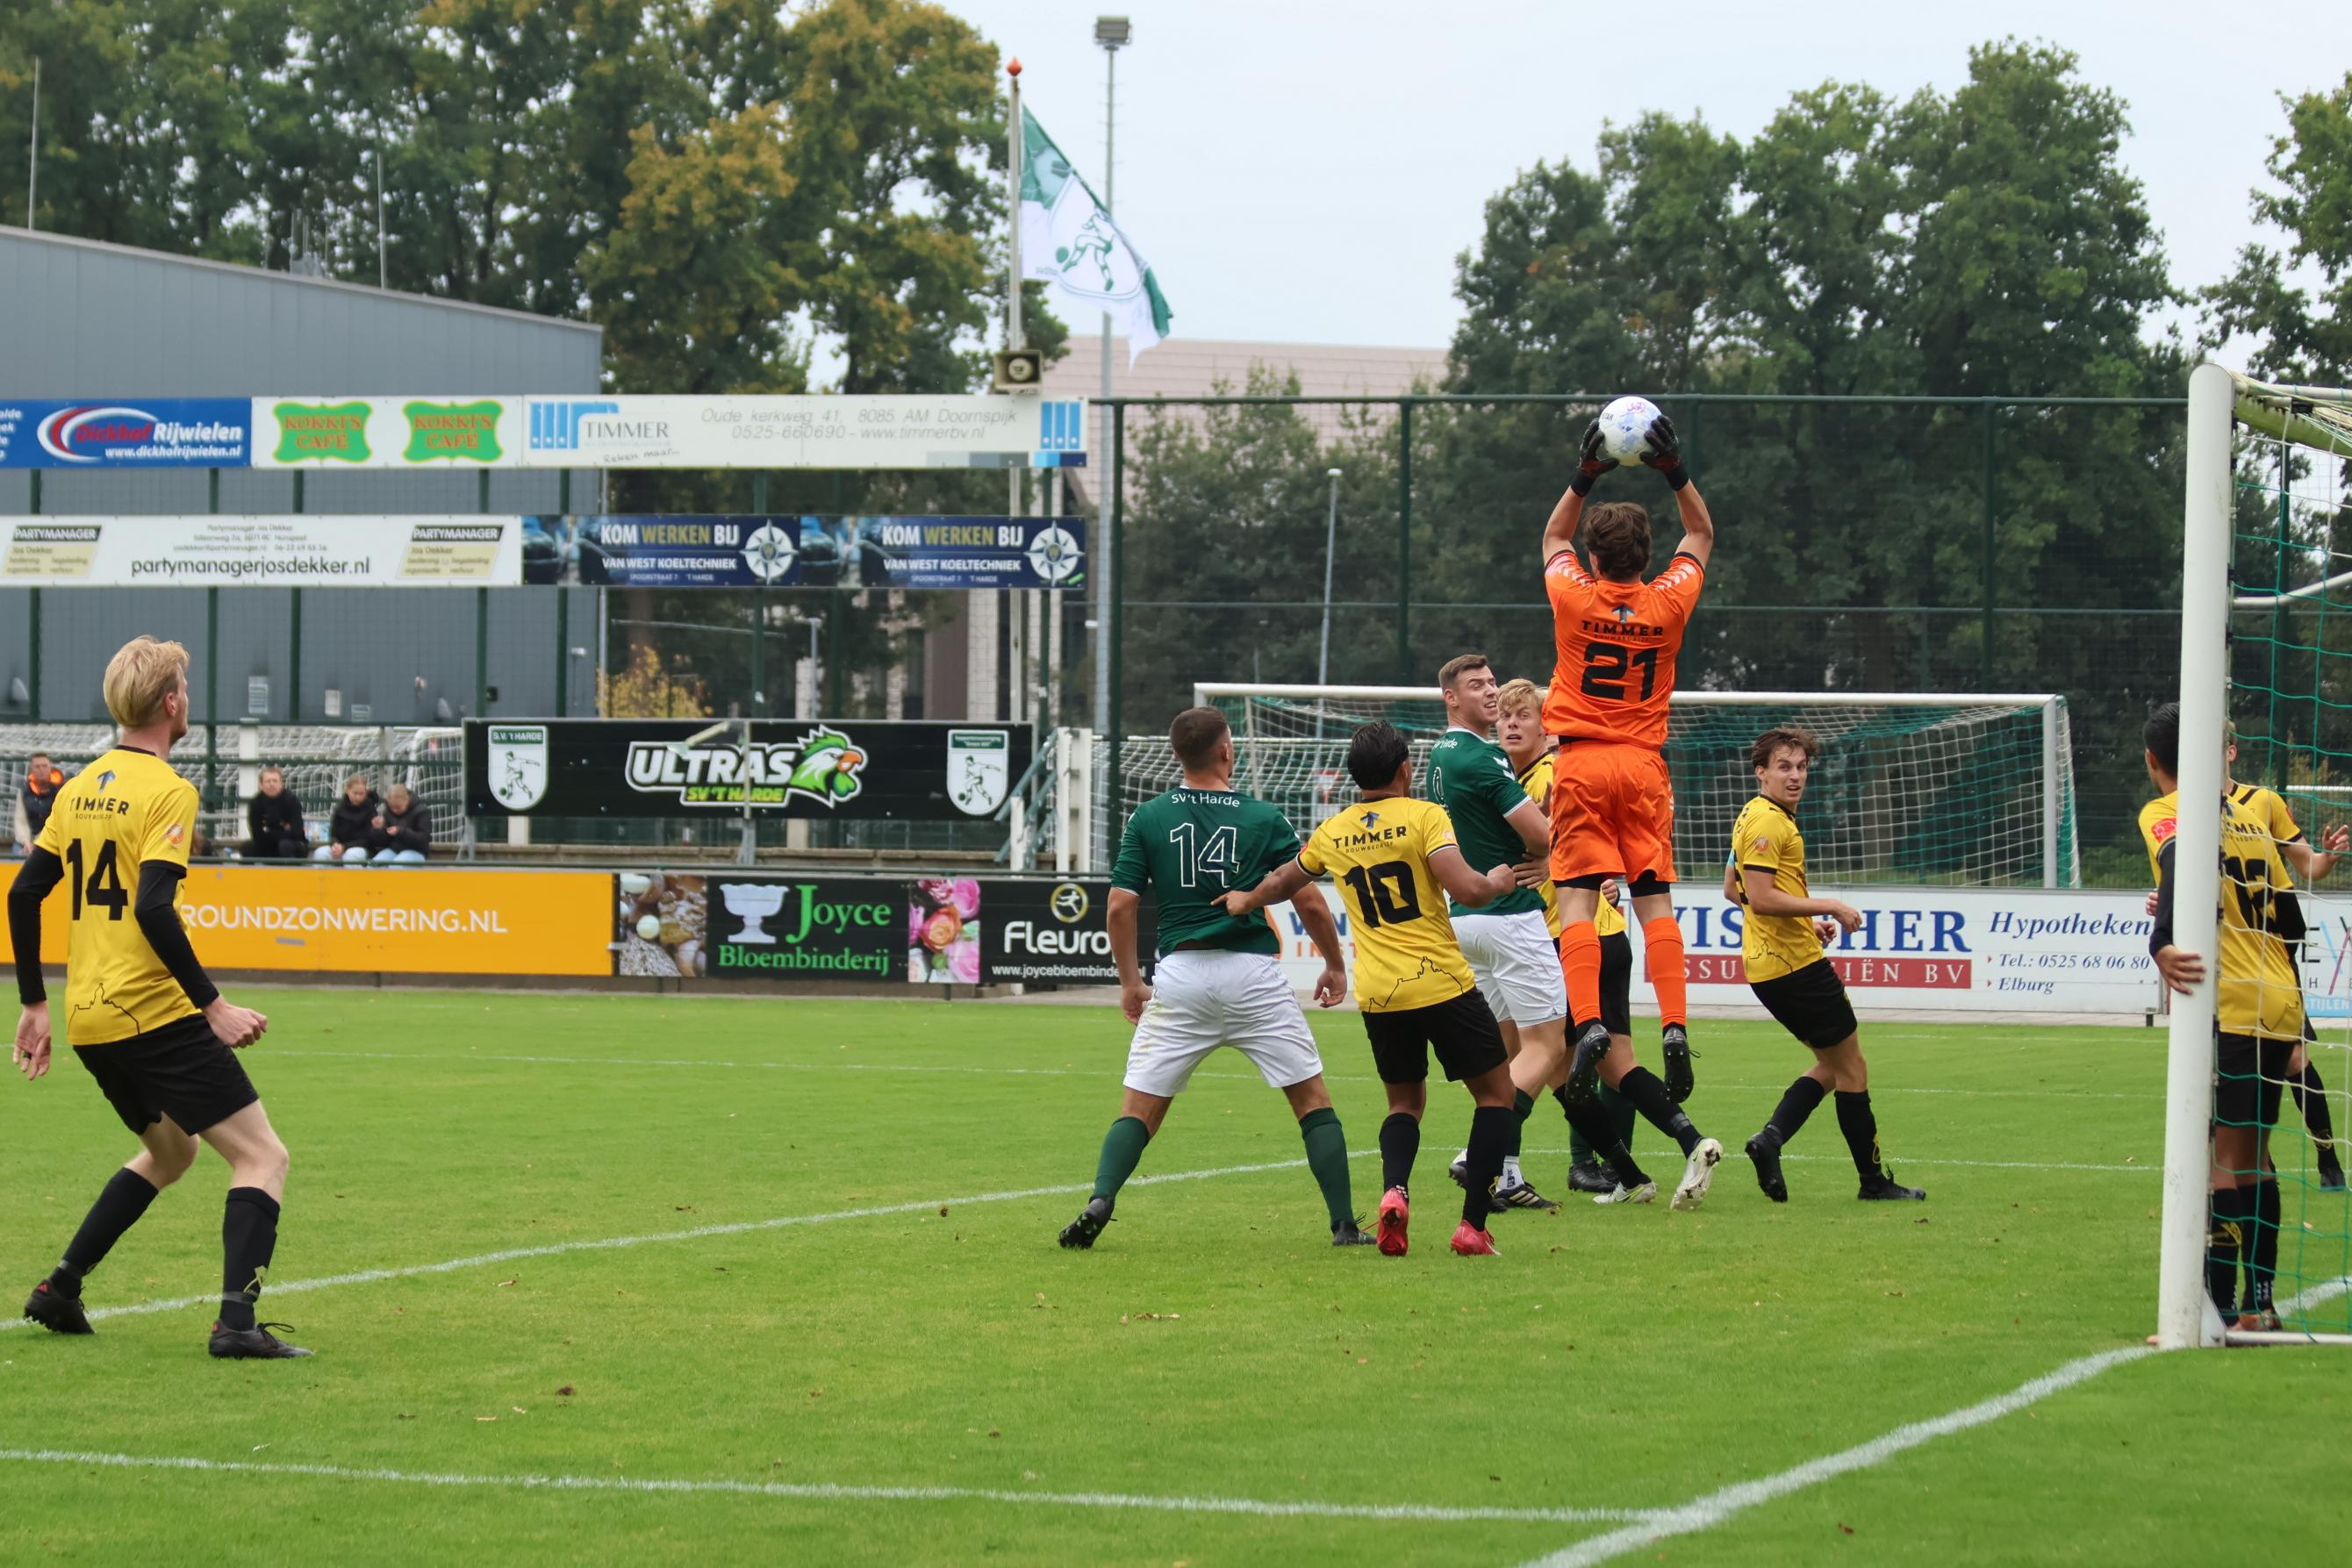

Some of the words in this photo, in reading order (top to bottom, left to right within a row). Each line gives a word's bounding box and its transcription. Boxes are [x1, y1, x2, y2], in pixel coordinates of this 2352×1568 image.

[284, 415, 362, 429] KOKKI'S
[413, 414, 492, 429] KOKKI'S
[702, 407, 742, 423] Oude
[750, 408, 814, 426] kerkweg
[857, 409, 895, 423] 8085
[902, 409, 930, 423] AM
[937, 408, 1017, 426] Doornspijk
[75, 421, 153, 442] Dickhof
[154, 422, 242, 444] Rijwielen
[585, 421, 670, 438] TIMMER
[732, 425, 846, 439] 0525-660690
[860, 426, 986, 440] www.timmerbv.nl
[104, 445, 241, 461] www.dickhofrijwielen.nl
[14, 528, 97, 540] PARTYMANAGER
[412, 527, 498, 539] PARTYMANAGER
[600, 524, 638, 546] KOM
[641, 524, 711, 546] WERKEN
[713, 524, 741, 546] BIJ
[882, 525, 921, 547] KOM
[924, 525, 994, 547] WERKEN
[997, 526, 1024, 547] BIJ
[131, 555, 370, 577] partymanagerjosdekker.nl
[602, 557, 626, 569] VAN
[626, 557, 656, 569] WEST
[657, 557, 737, 569] KOELTECHNIEK
[883, 559, 907, 570] VAN
[907, 559, 939, 570] WEST
[940, 559, 1022, 570] KOELTECHNIEK
[1581, 620, 1664, 636] TIMMER
[1581, 642, 1660, 702] 21
[514, 731, 542, 741] HARDE
[632, 748, 796, 784] ULTRAS
[686, 786, 710, 801] SV
[1199, 792, 1241, 807] Harde
[1333, 826, 1408, 849] TIMMER
[1170, 822, 1240, 888] 14
[66, 838, 129, 921] 14
[1342, 861, 1423, 928] 10
[785, 884, 893, 944] Joyce
[1989, 911, 2151, 940] Hypotheken
[1004, 921, 1115, 956] Fleuro
[717, 944, 890, 977] Bloembinderij
[1999, 953, 2033, 968] Tel.:
[2039, 954, 2077, 968] 0525
[2083, 955, 2102, 969] 68
[2106, 955, 2126, 969] 06
[2130, 955, 2150, 970] 80
[1925, 963, 1965, 984] BV
[1998, 977, 2054, 995] Elburg
